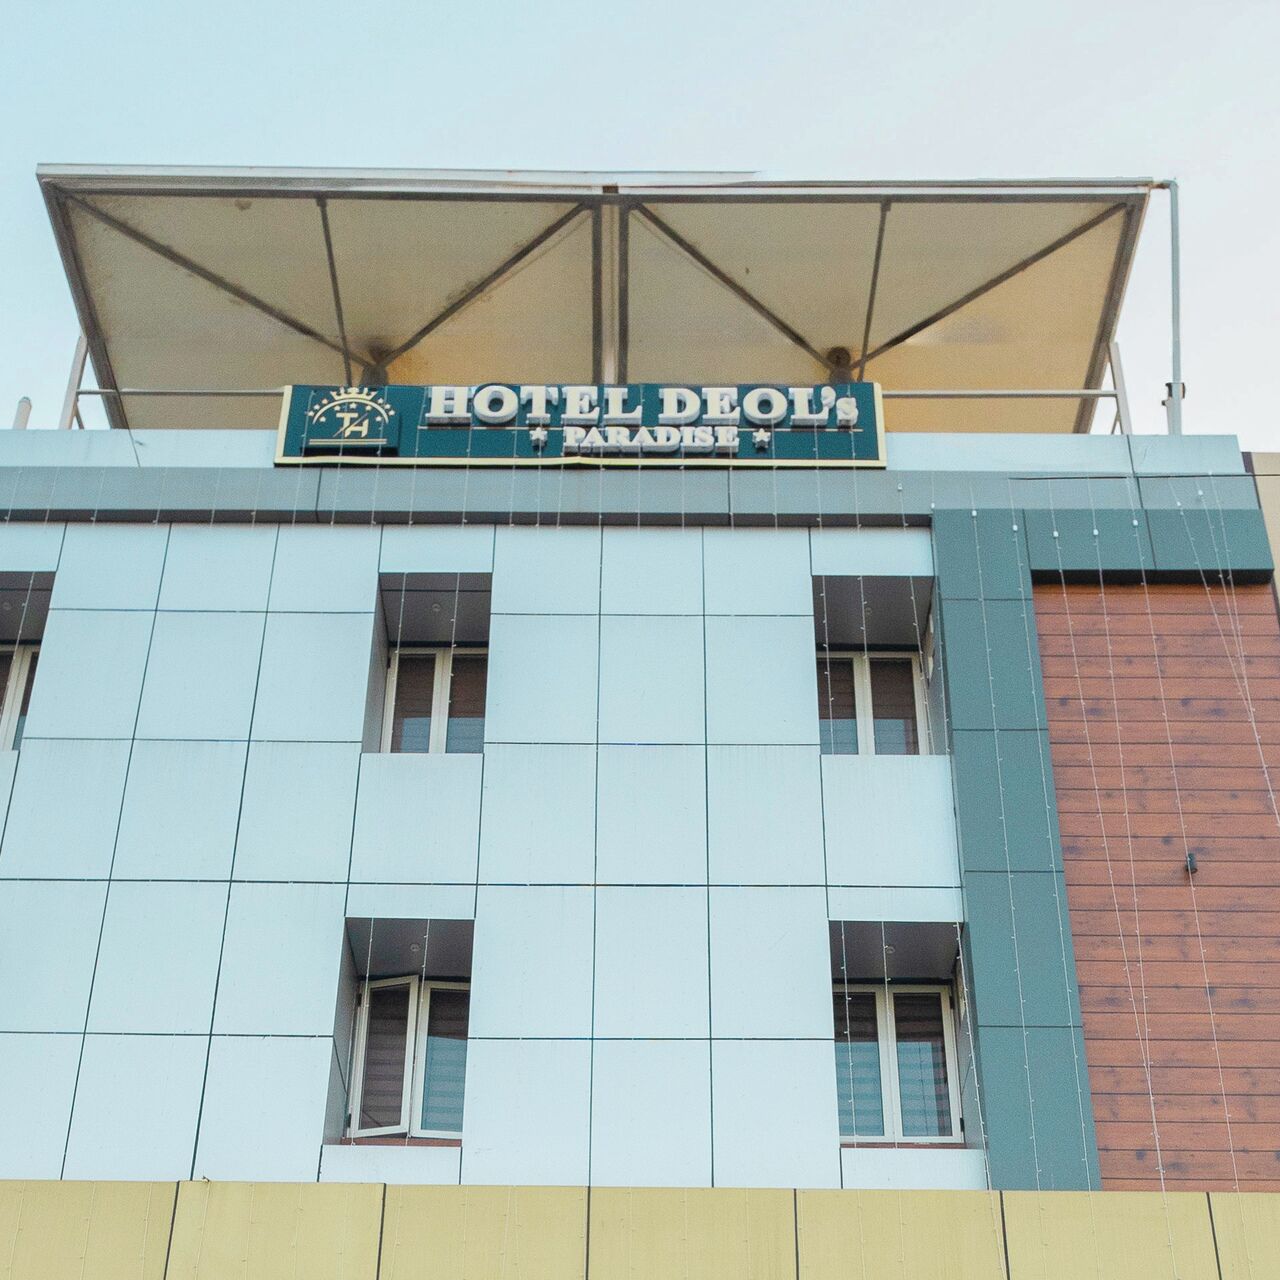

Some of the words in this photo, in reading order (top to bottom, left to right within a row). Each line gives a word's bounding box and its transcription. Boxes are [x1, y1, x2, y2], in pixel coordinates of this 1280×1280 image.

[425, 384, 641, 425] HOTEL
[658, 386, 859, 426] DEOL's
[563, 426, 740, 454] PARADISE
